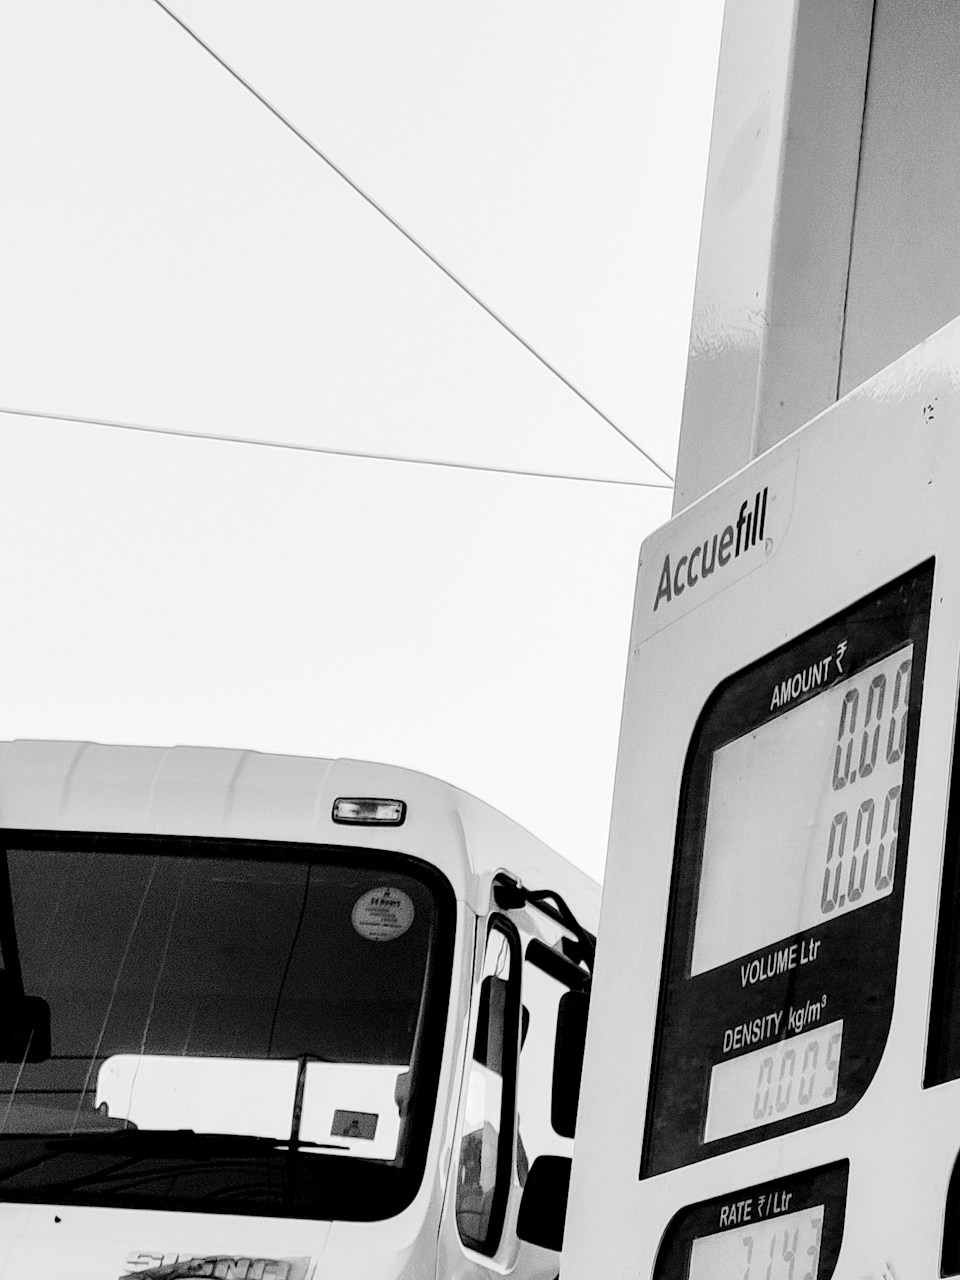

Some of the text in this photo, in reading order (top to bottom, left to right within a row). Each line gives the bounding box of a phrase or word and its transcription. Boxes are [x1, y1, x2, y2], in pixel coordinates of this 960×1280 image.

[653, 486, 768, 612] Accuefill
[770, 655, 832, 712] AMOUNT
[833, 659, 911, 791] 0.00
[820, 785, 901, 914] 0.00
[741, 938, 821, 988] VOLUME Ltr
[723, 1010, 783, 1053] DENSITY
[719, 1199, 753, 1227] RATE
